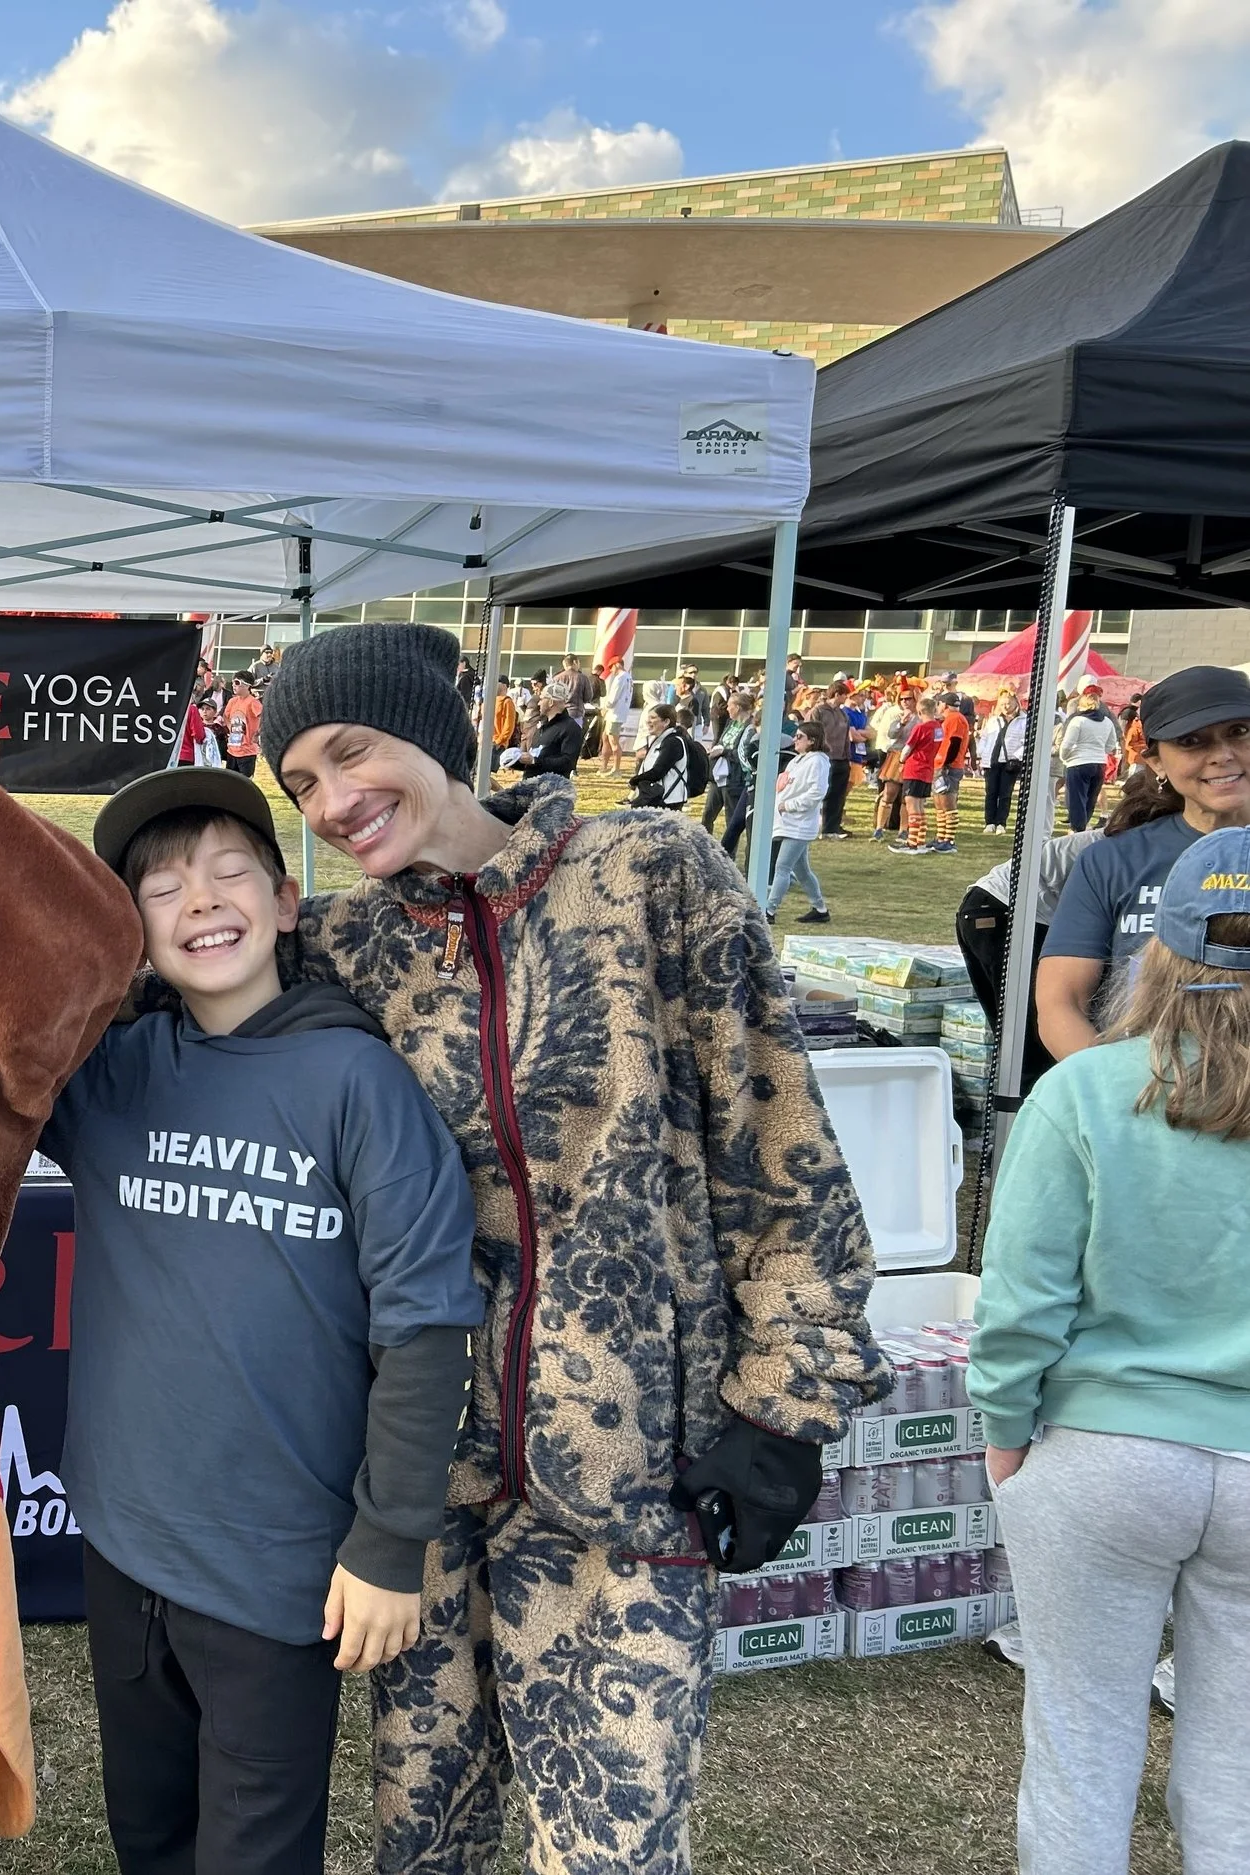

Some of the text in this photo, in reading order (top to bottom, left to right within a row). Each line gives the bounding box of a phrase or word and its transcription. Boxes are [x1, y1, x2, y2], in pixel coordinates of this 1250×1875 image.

[681, 430, 764, 442] CARAVAN
[23, 673, 141, 707] YOGA
[23, 711, 177, 744] FITNESS
[147, 1131, 317, 1187] HEAVILY
[118, 1175, 344, 1240] MEDITATED
[905, 1422, 952, 1440] CLEAN
[890, 1444, 962, 1460] ORGANIC YERBA MATE
[902, 1518, 951, 1536] CLEAN
[886, 1541, 960, 1555] ORGANIC YERBA MATE
[772, 1563, 795, 1571] YERBA
[796, 1560, 815, 1568] MATE
[905, 1614, 952, 1633] CLEAN
[750, 1630, 799, 1650] CLEAN
[890, 1642, 920, 1652] ORGANIC
[921, 1639, 942, 1649] YERBA
[732, 1659, 764, 1668] ORGANIC
[765, 1656, 788, 1664] YERBA
[790, 1652, 808, 1660] MATE
